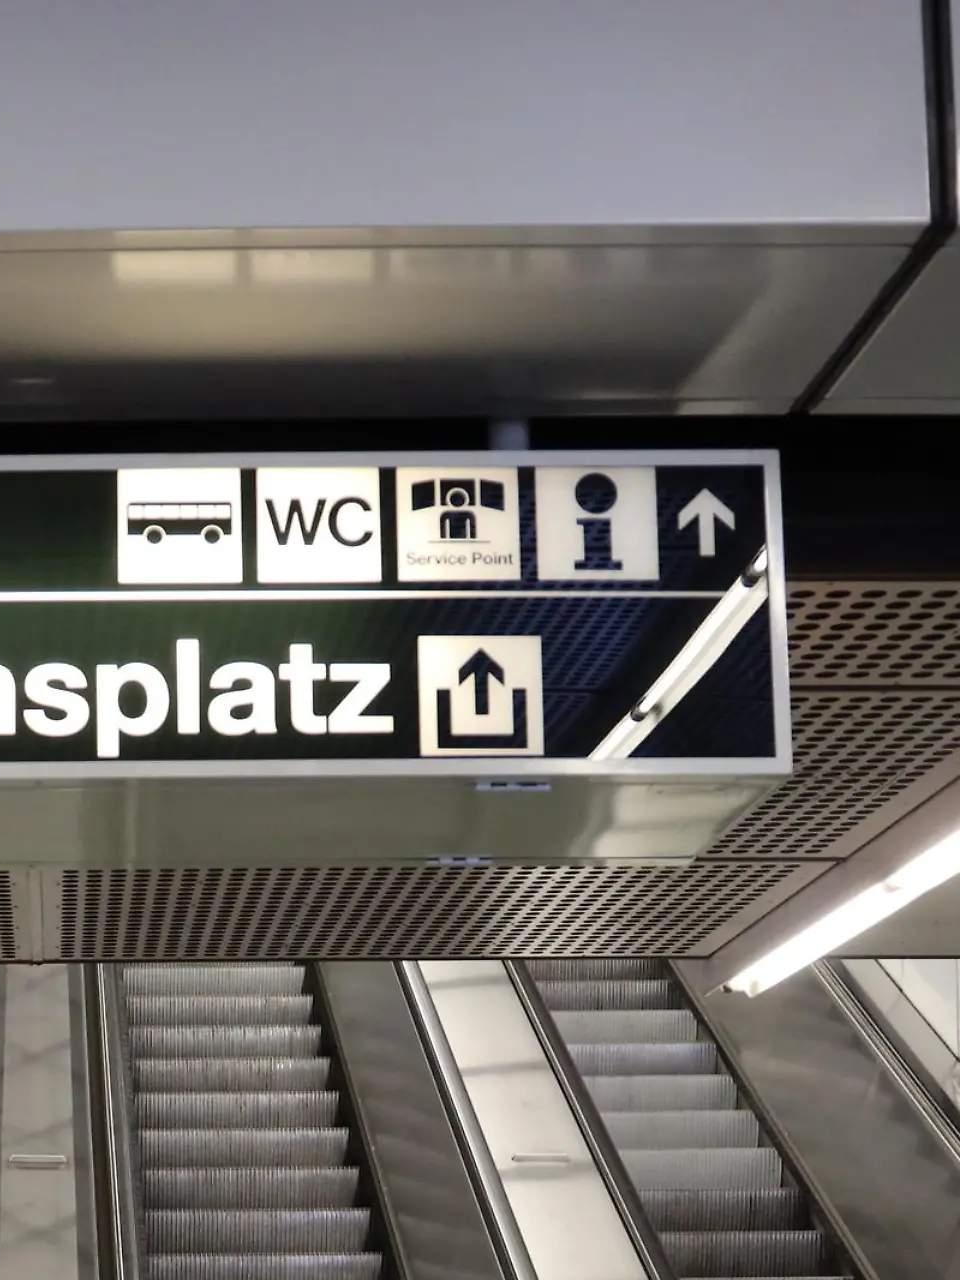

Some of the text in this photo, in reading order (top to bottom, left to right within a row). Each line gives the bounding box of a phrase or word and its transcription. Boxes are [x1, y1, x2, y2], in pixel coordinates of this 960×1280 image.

[265, 496, 373, 547] WC
[406, 551, 514, 567] Service Point
